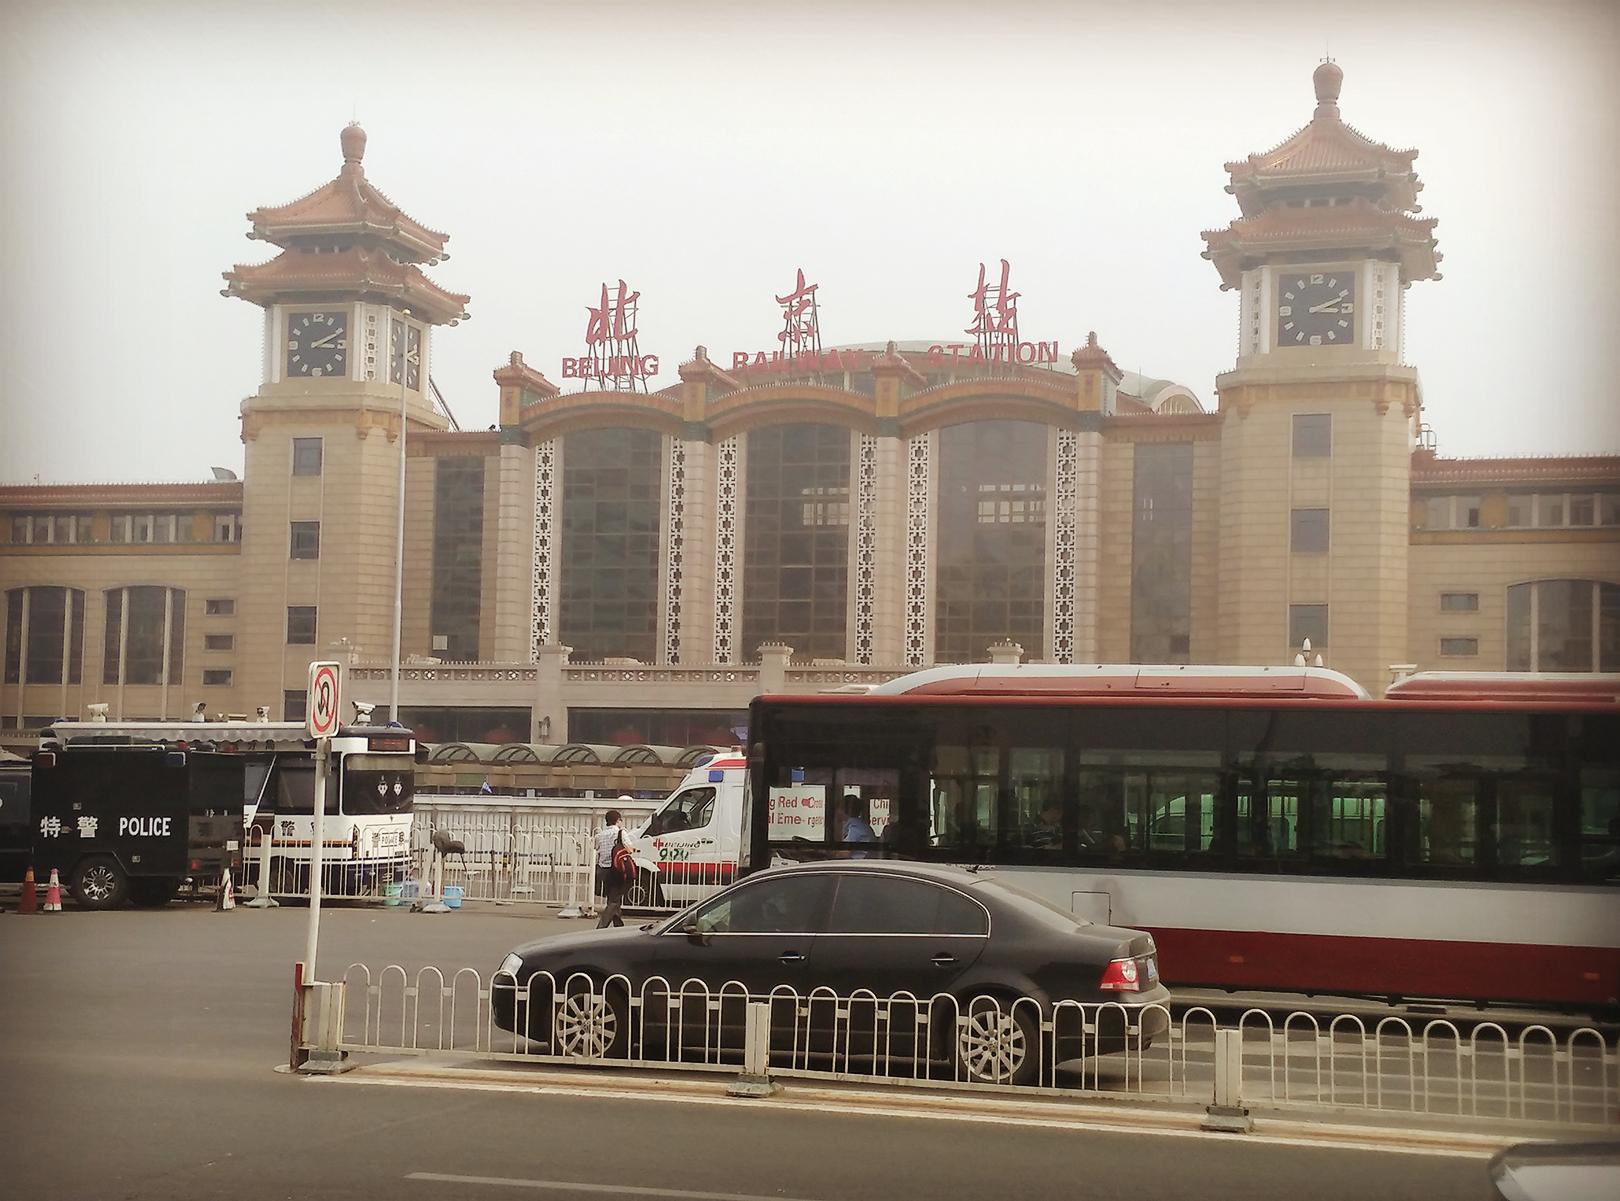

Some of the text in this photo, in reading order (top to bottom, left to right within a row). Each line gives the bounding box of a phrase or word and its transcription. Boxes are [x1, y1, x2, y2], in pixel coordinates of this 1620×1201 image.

[562, 341, 1058, 378] BEIJING RAILWAY STATION
[779, 796, 798, 808] Red
[40, 816, 172, 838] 特警 POLICE
